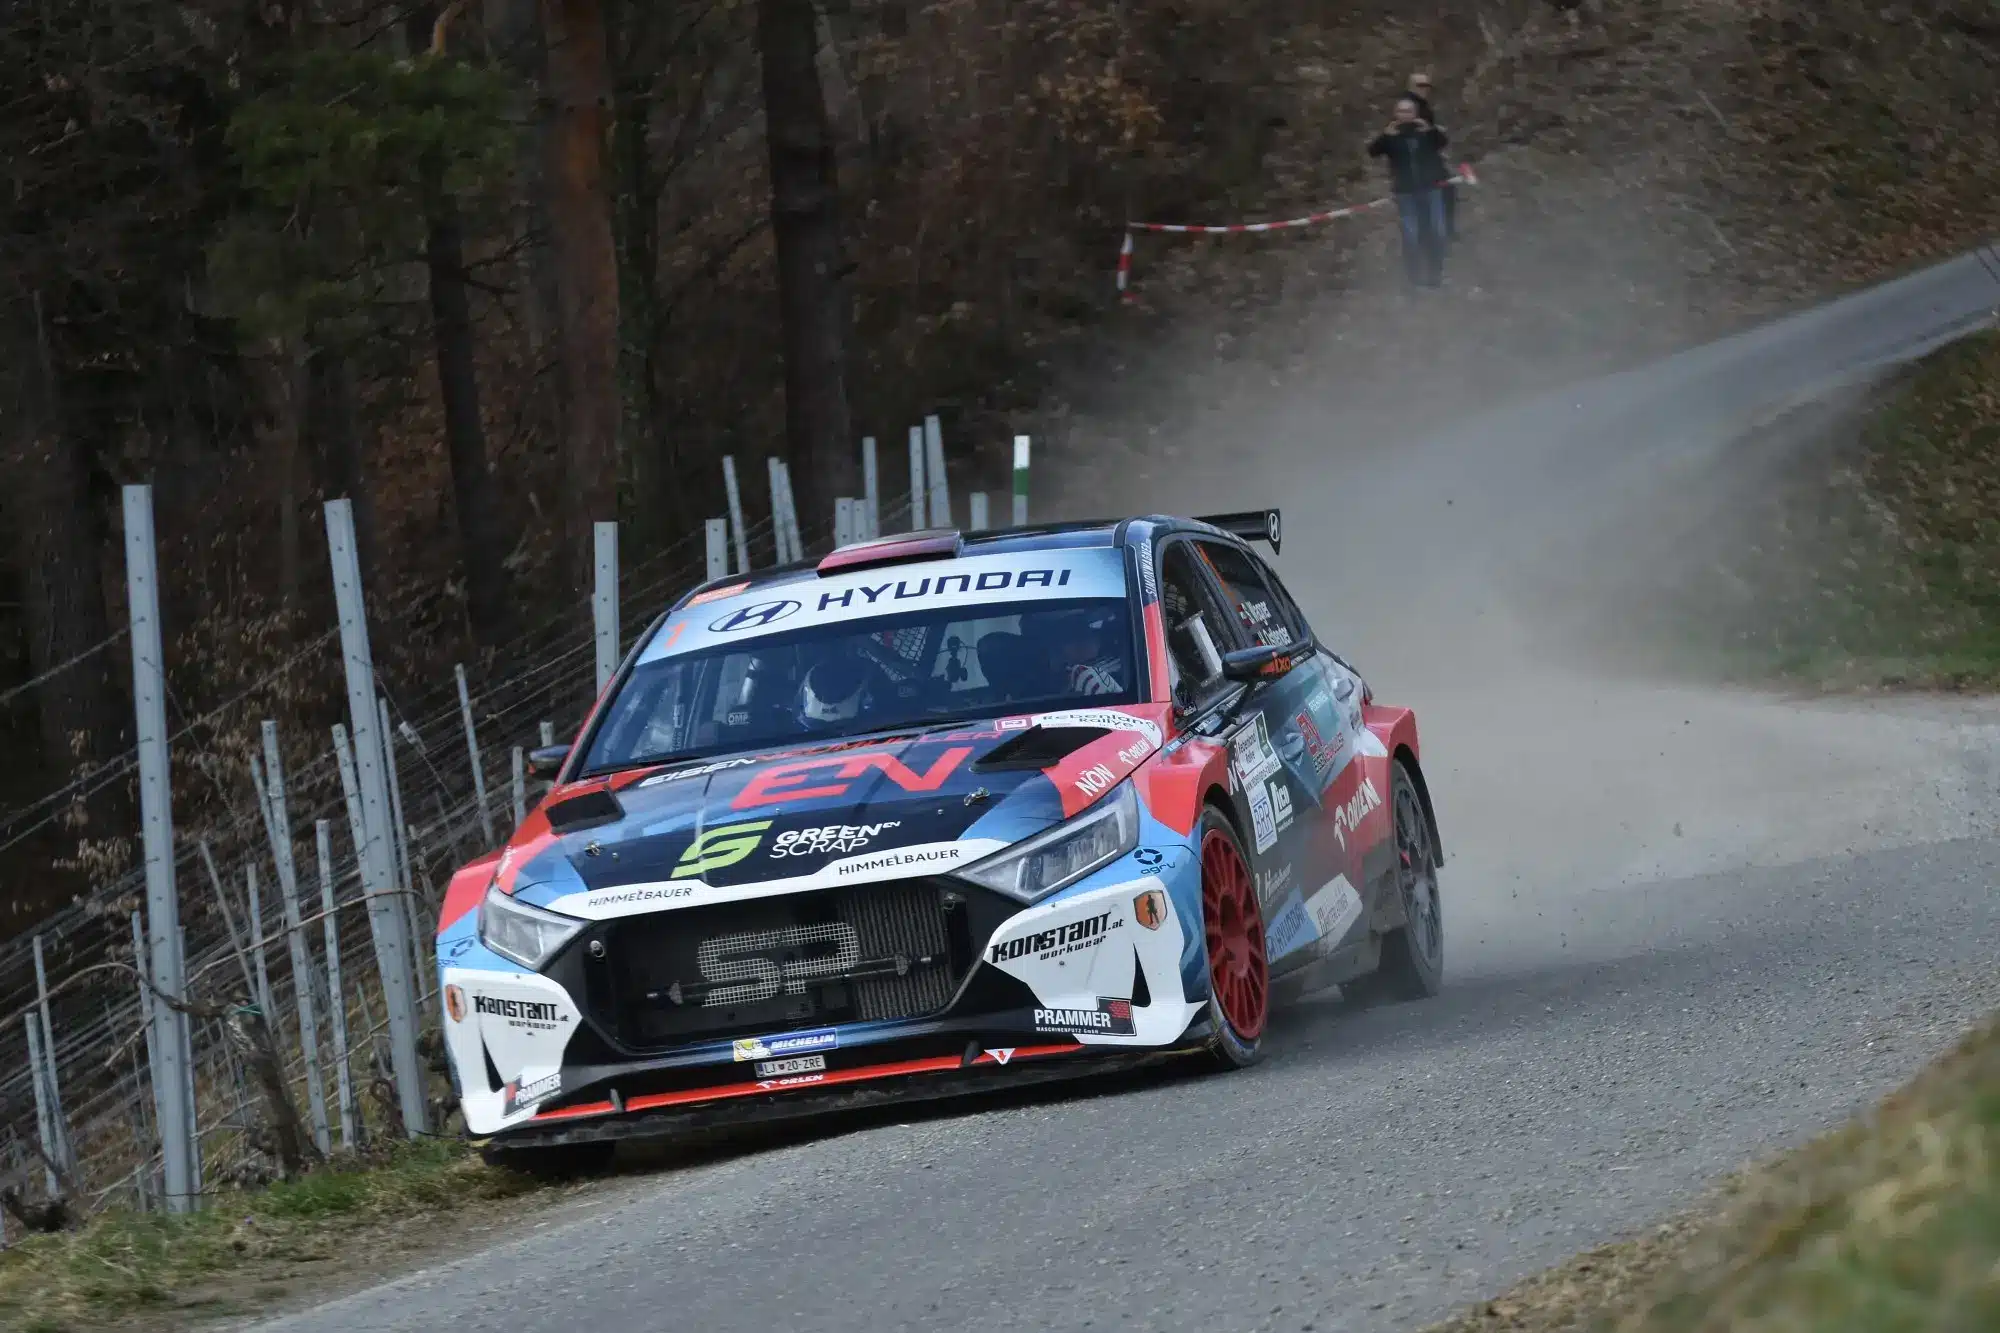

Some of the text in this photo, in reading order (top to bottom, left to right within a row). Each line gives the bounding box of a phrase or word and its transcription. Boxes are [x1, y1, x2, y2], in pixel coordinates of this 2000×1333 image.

[817, 569, 1072, 611] HYUNDAI
[665, 620, 687, 649] 1
[730, 746, 974, 811] EN
[1074, 763, 1115, 797] NÖN
[1347, 777, 1382, 832] ORLEN
[776, 823, 884, 846] GREEN
[769, 837, 869, 859] SCRAP
[839, 849, 960, 876] HIMMELBAUER
[588, 887, 693, 907] HIMMELBAUER
[1040, 935, 1107, 961] workwear
[508, 1019, 557, 1030] workwear
[1034, 1008, 1112, 1028] PRAMMER
[770, 1034, 835, 1050] MICHELIN
[763, 1057, 822, 1074] LJ 20-ZRE
[779, 1074, 824, 1085] ORLEN
